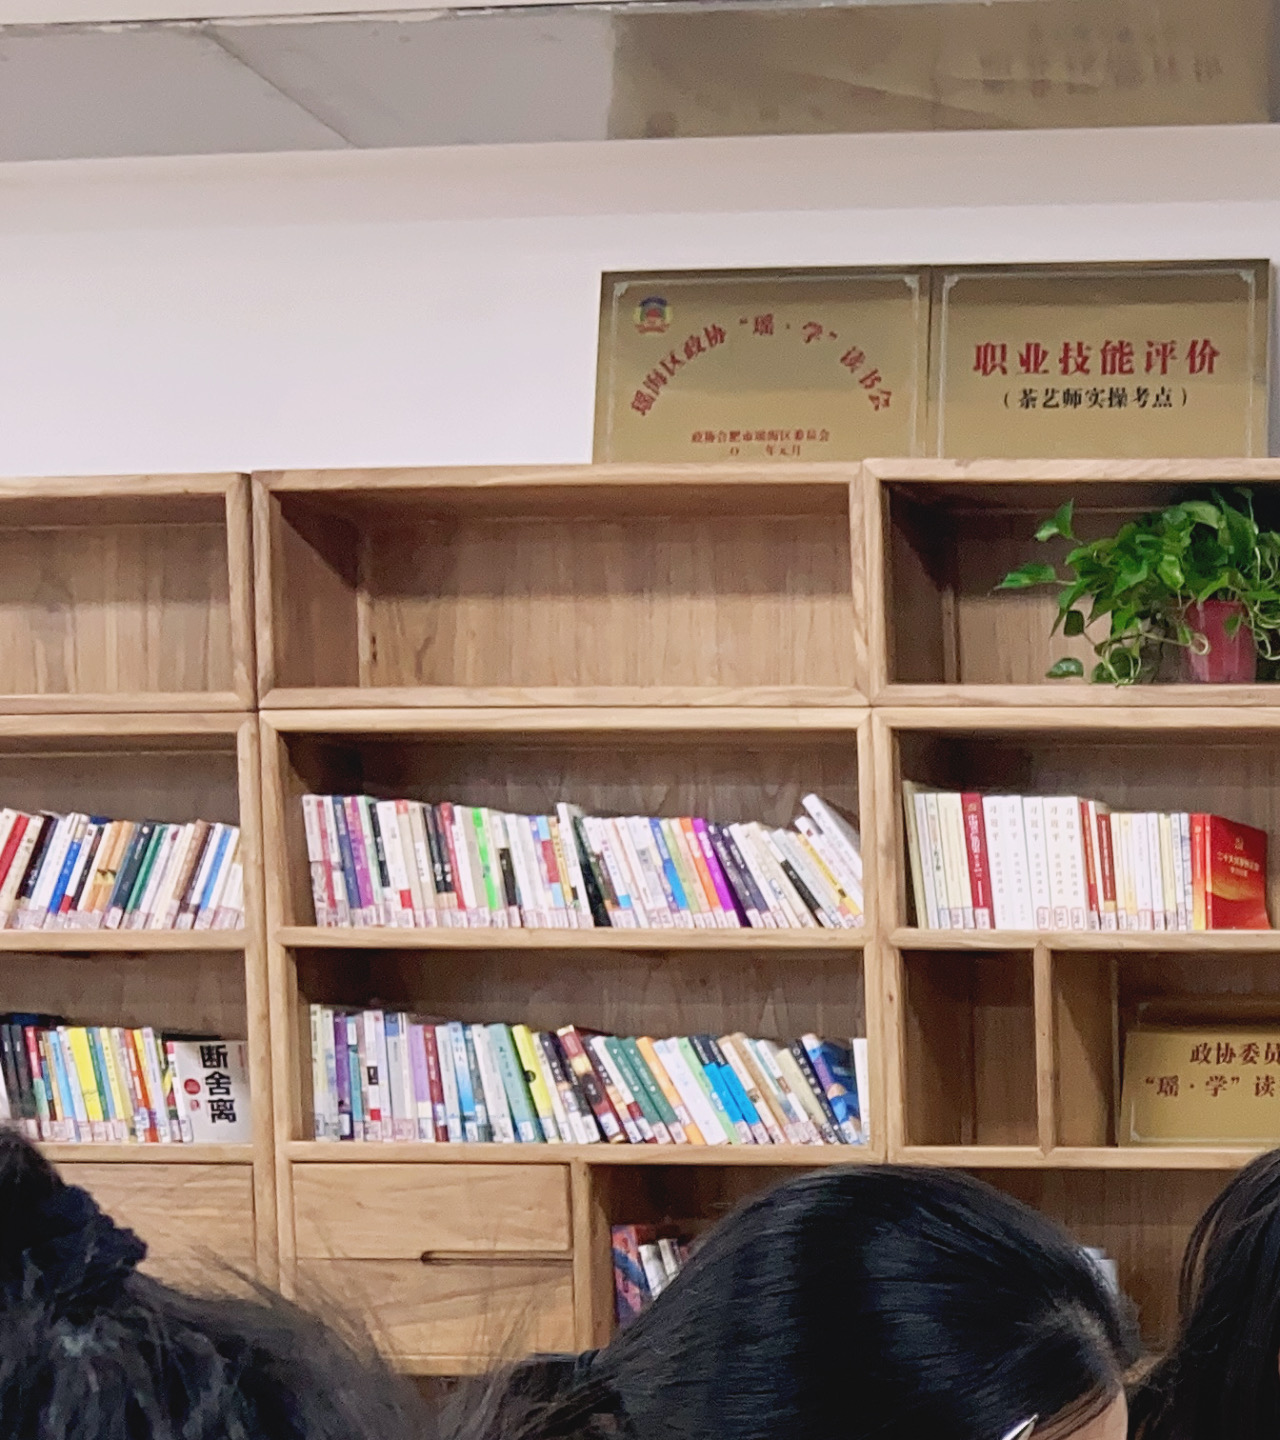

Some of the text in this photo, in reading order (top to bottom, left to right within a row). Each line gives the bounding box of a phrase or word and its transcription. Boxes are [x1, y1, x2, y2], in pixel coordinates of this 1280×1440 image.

[973, 339, 1220, 376] 职业技能评价
[200, 1044, 237, 1123] 断舍离
